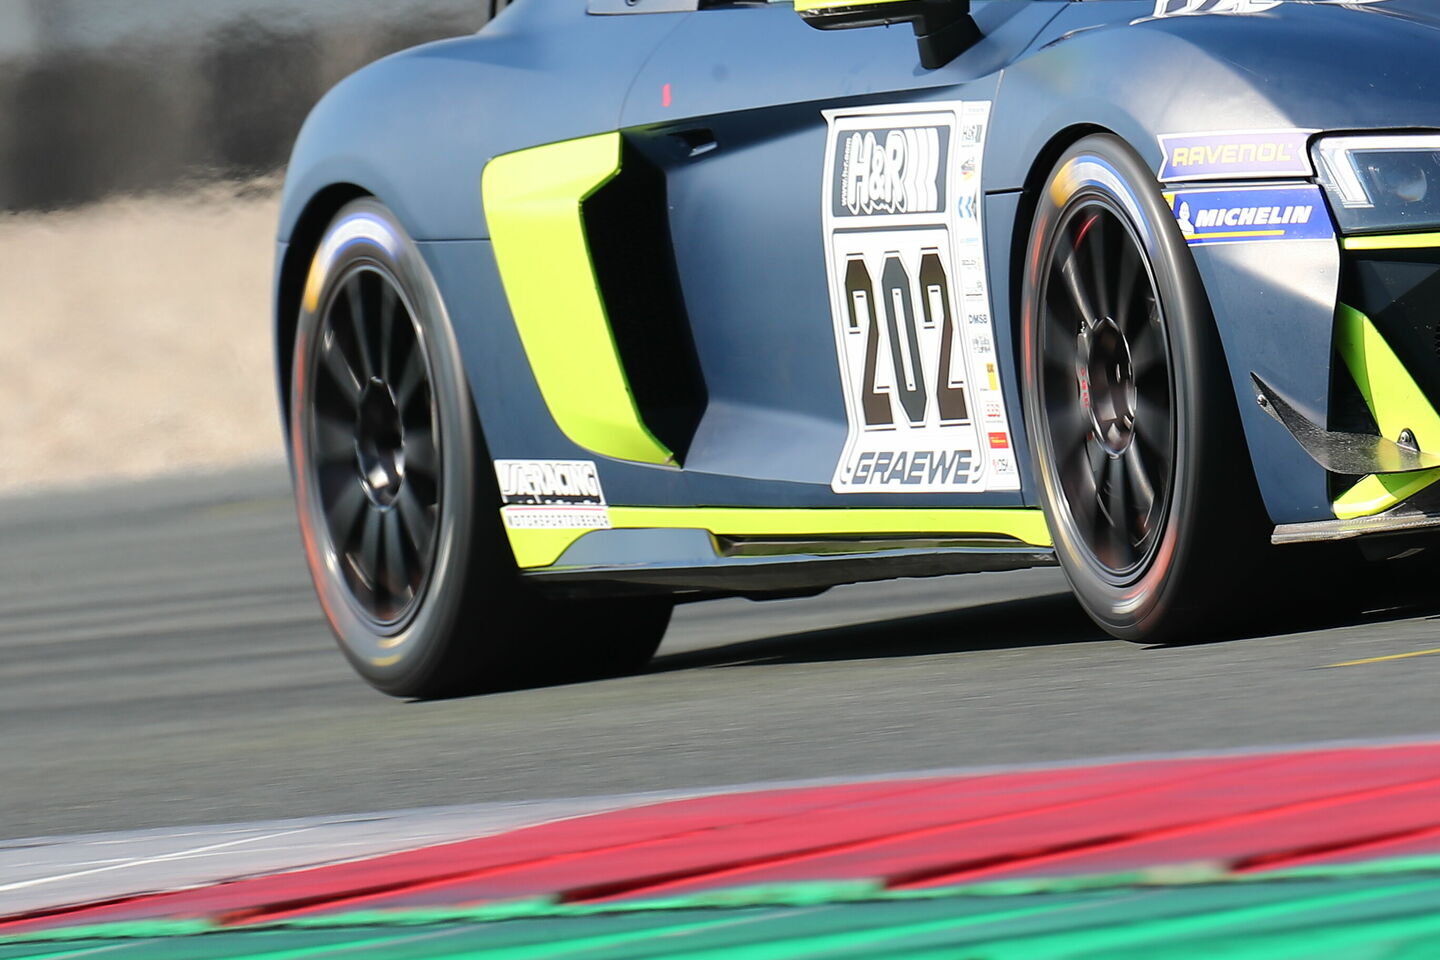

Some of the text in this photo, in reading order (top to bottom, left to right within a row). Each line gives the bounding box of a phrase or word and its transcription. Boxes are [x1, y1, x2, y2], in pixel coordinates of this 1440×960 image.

[848, 130, 906, 214] H&R
[1172, 143, 1292, 167] RAVENOL
[1195, 205, 1313, 228] MICHELIN
[845, 247, 971, 431] 202
[851, 449, 973, 485] GRAEWE
